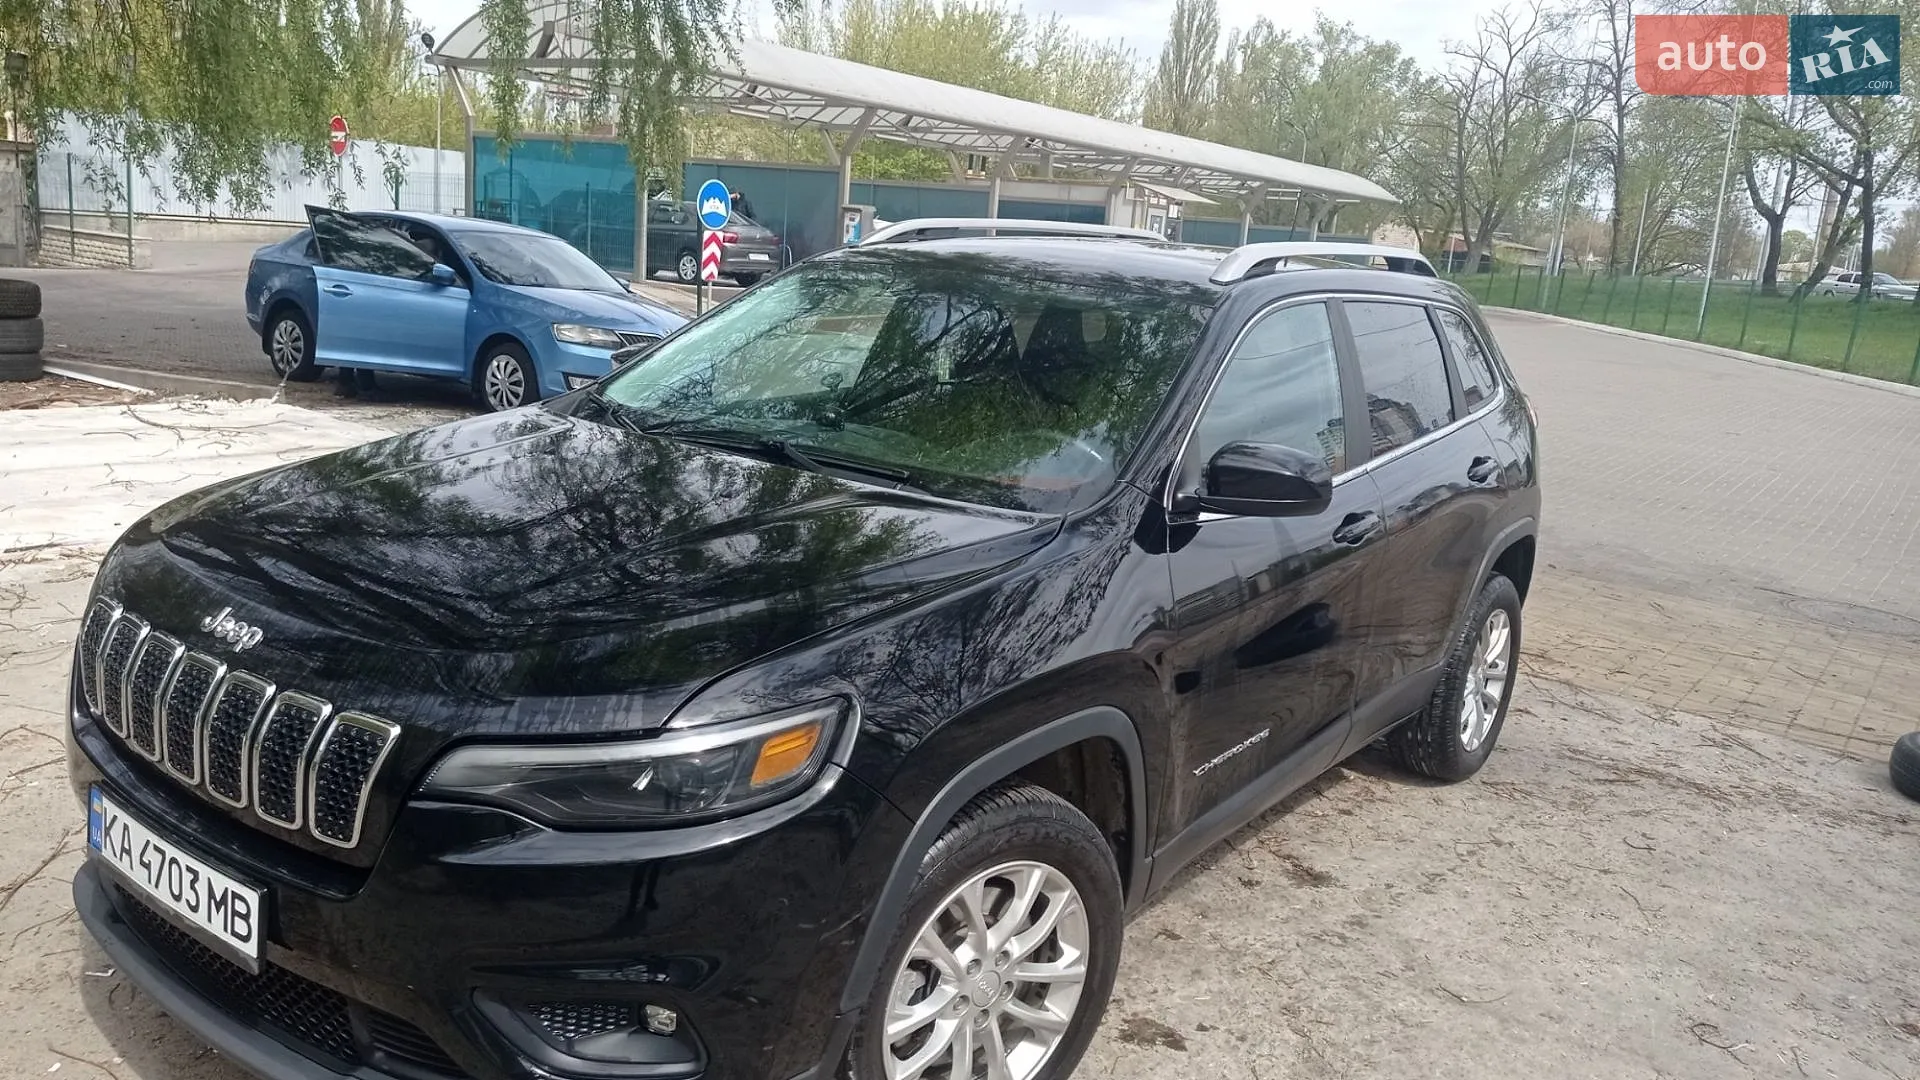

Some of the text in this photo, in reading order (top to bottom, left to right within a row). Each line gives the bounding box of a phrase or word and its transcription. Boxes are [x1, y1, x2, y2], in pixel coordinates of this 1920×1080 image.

[200, 606, 264, 653] Jeep
[103, 806, 252, 944] KA 4703 MB
